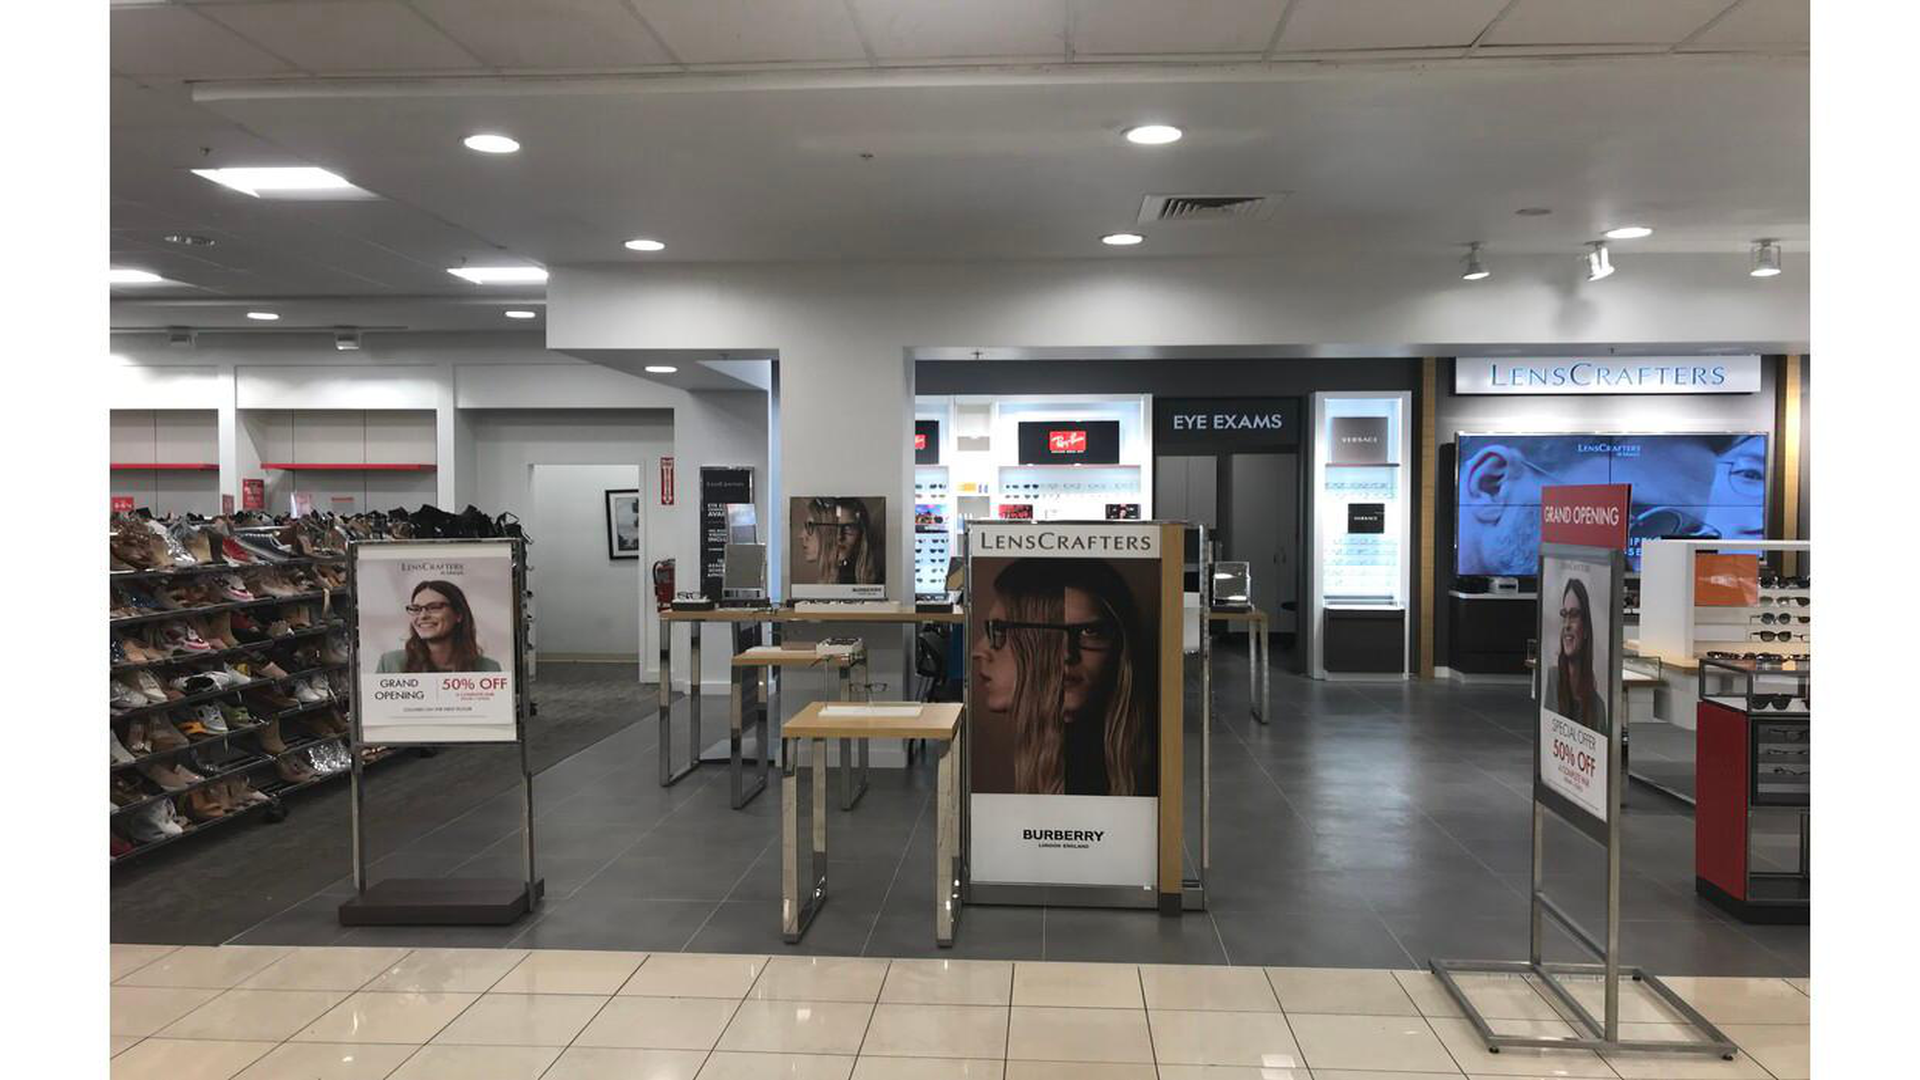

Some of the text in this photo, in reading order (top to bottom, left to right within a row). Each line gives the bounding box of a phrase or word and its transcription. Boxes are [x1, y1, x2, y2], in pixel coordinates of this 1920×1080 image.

[1173, 414, 1283, 430] EYE EXAMS
[1544, 505, 1620, 526] GRAND OPENING
[379, 678, 419, 688] GRAND
[442, 677, 508, 690] 50% OFF
[374, 690, 425, 701] OPENING
[1552, 718, 1597, 752] SPECIAL OFFER
[1553, 739, 1596, 778] 50% OFF
[1023, 829, 1104, 842] BURBERRY
